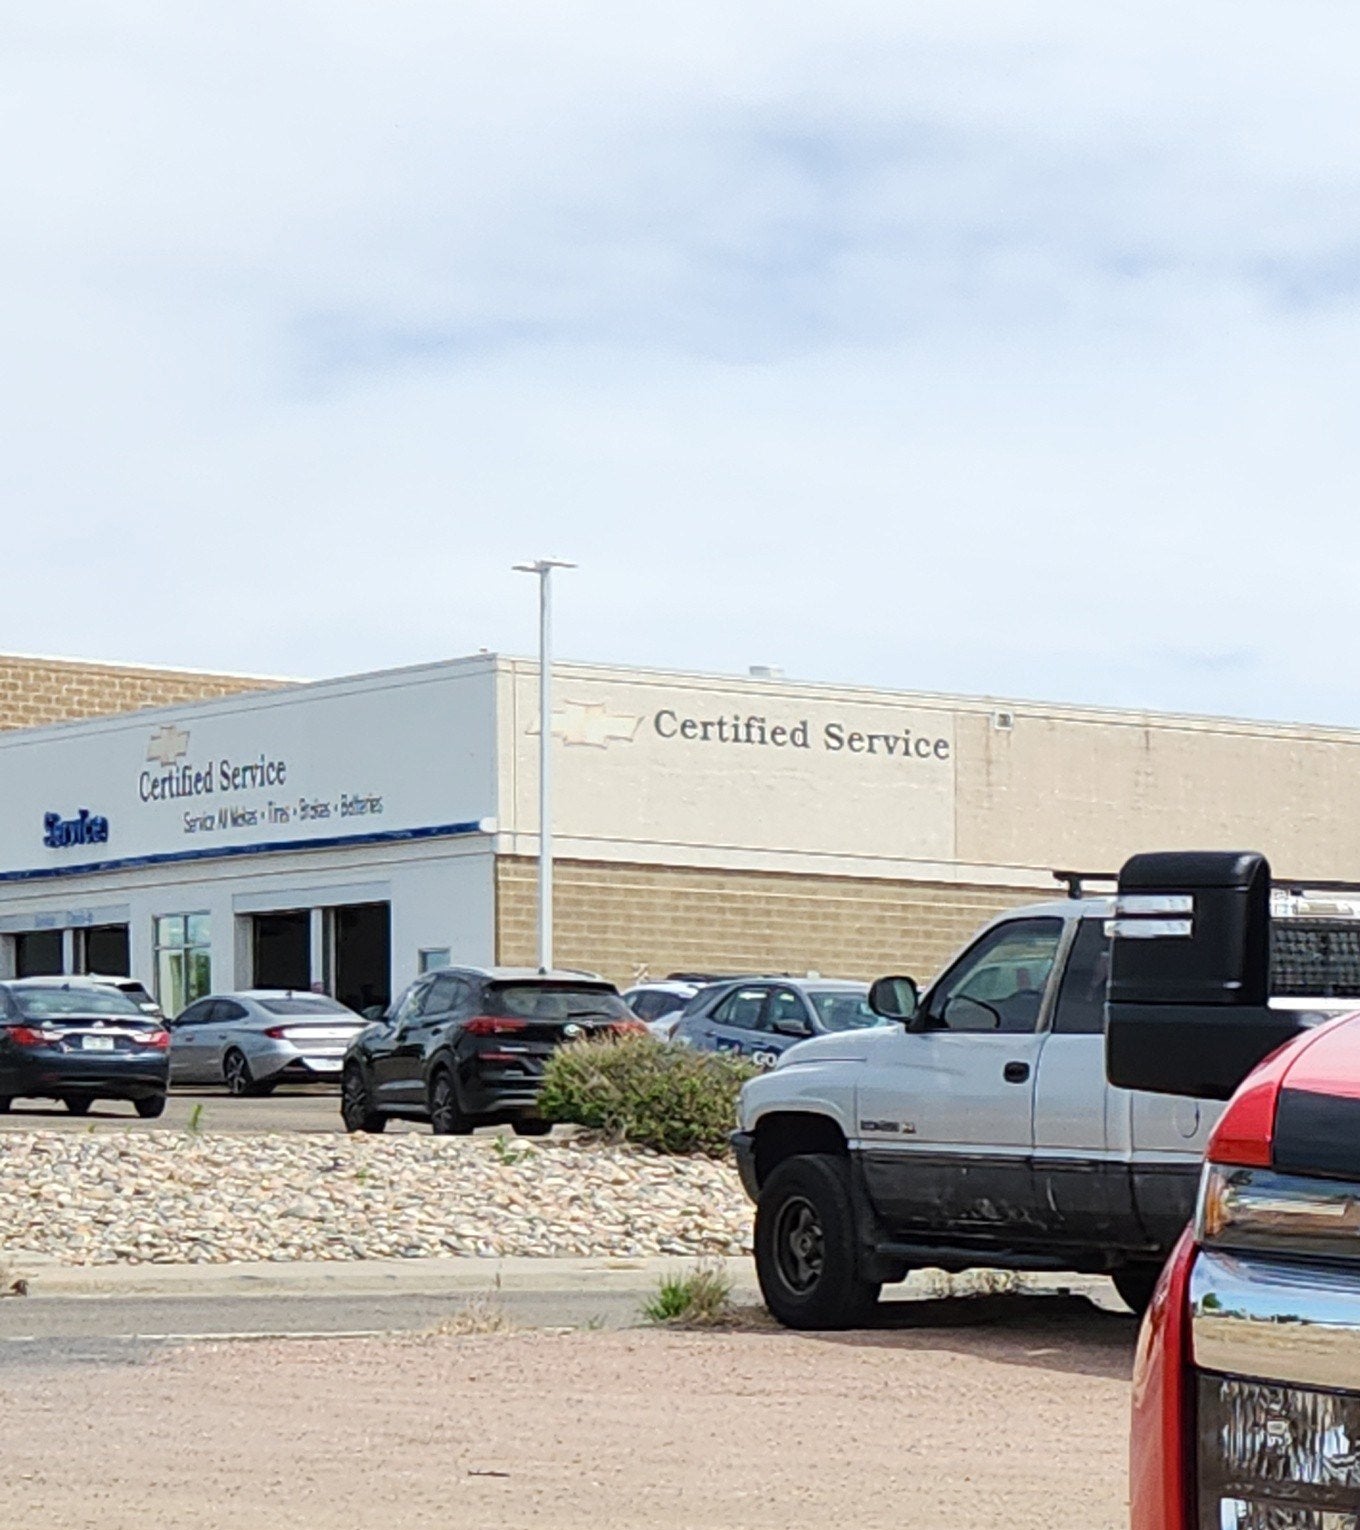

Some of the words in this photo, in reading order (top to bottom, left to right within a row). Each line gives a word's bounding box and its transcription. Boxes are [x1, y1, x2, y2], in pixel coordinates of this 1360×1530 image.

[654, 710, 811, 750] Certified
[825, 724, 951, 760] Service
[139, 761, 213, 802] Certified
[220, 755, 287, 791] Service
